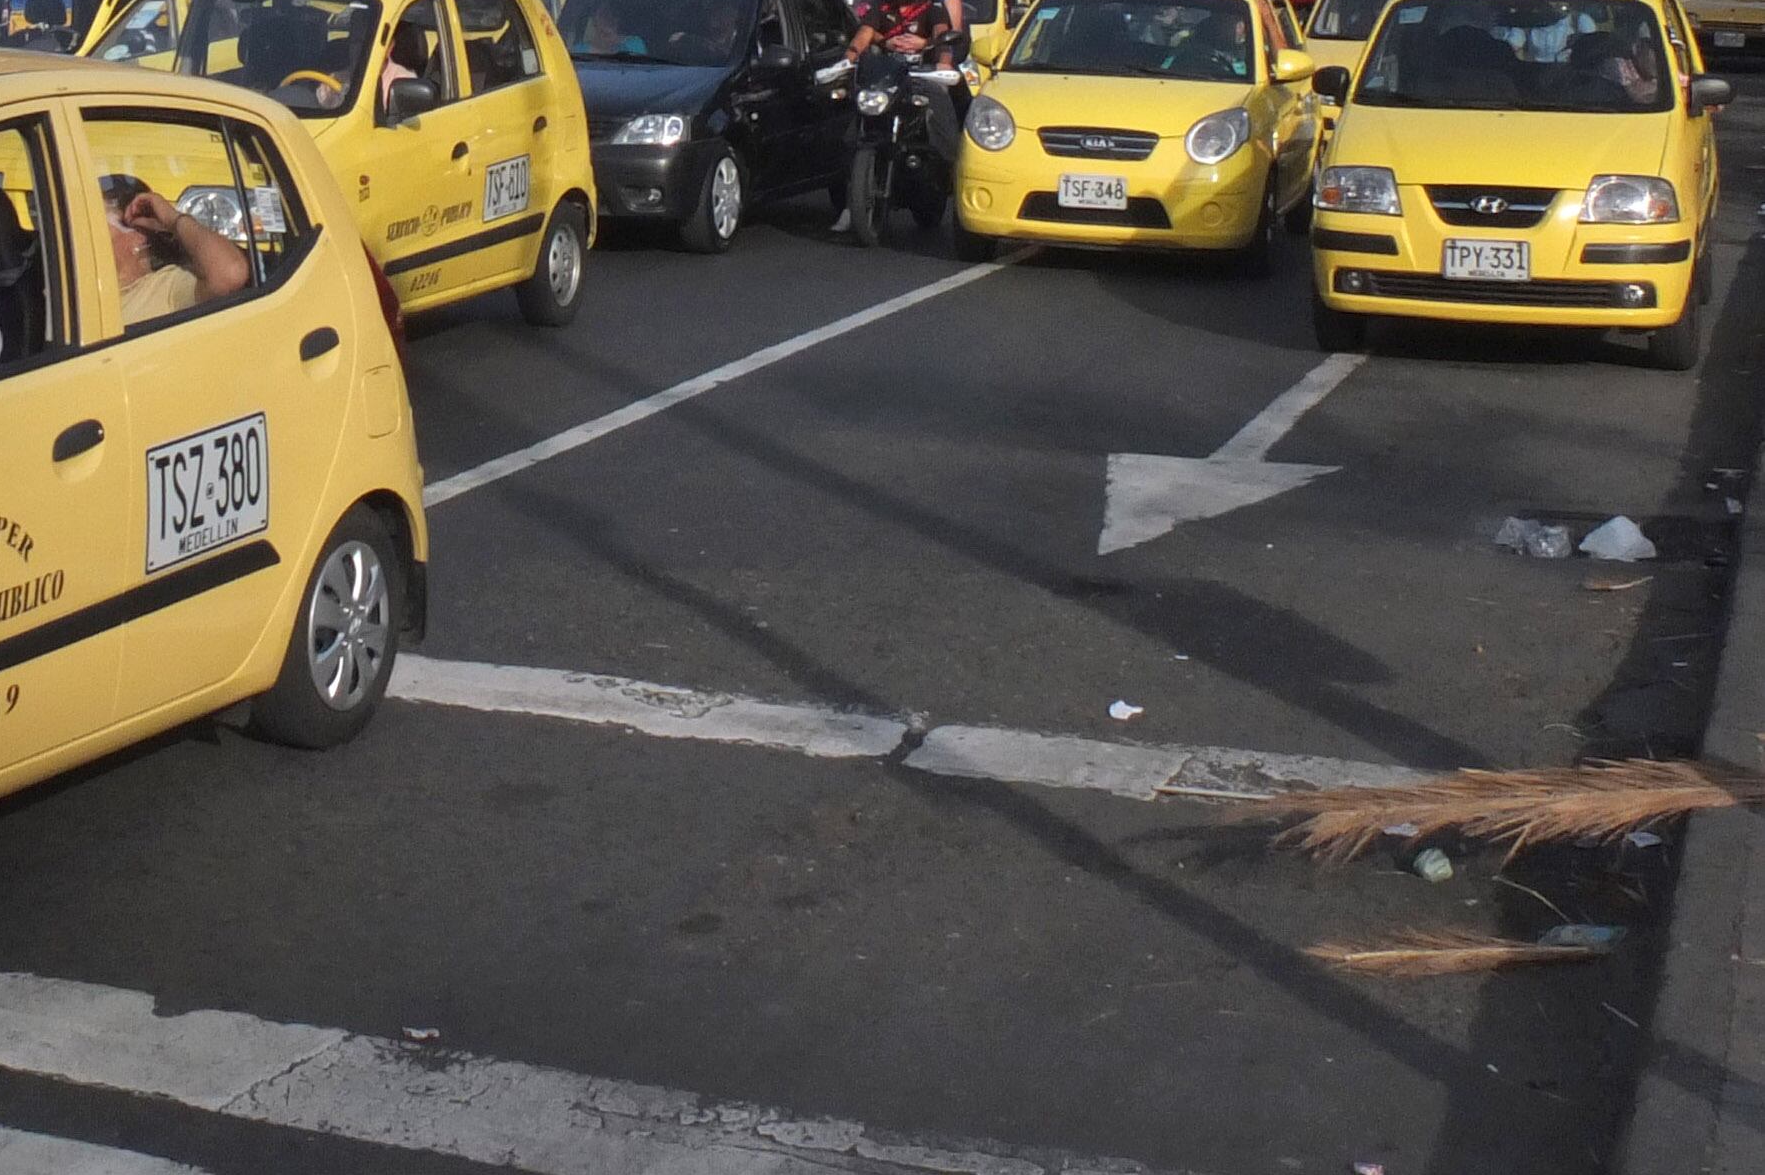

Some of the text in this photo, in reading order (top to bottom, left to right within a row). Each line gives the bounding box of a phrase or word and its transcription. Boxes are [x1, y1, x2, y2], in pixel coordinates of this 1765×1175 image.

[1085, 138, 1107, 148] KIA
[1063, 178, 1124, 200] TSF-348
[1446, 245, 1526, 270] TPY-331
[177, 517, 240, 557] MEDELLIN
